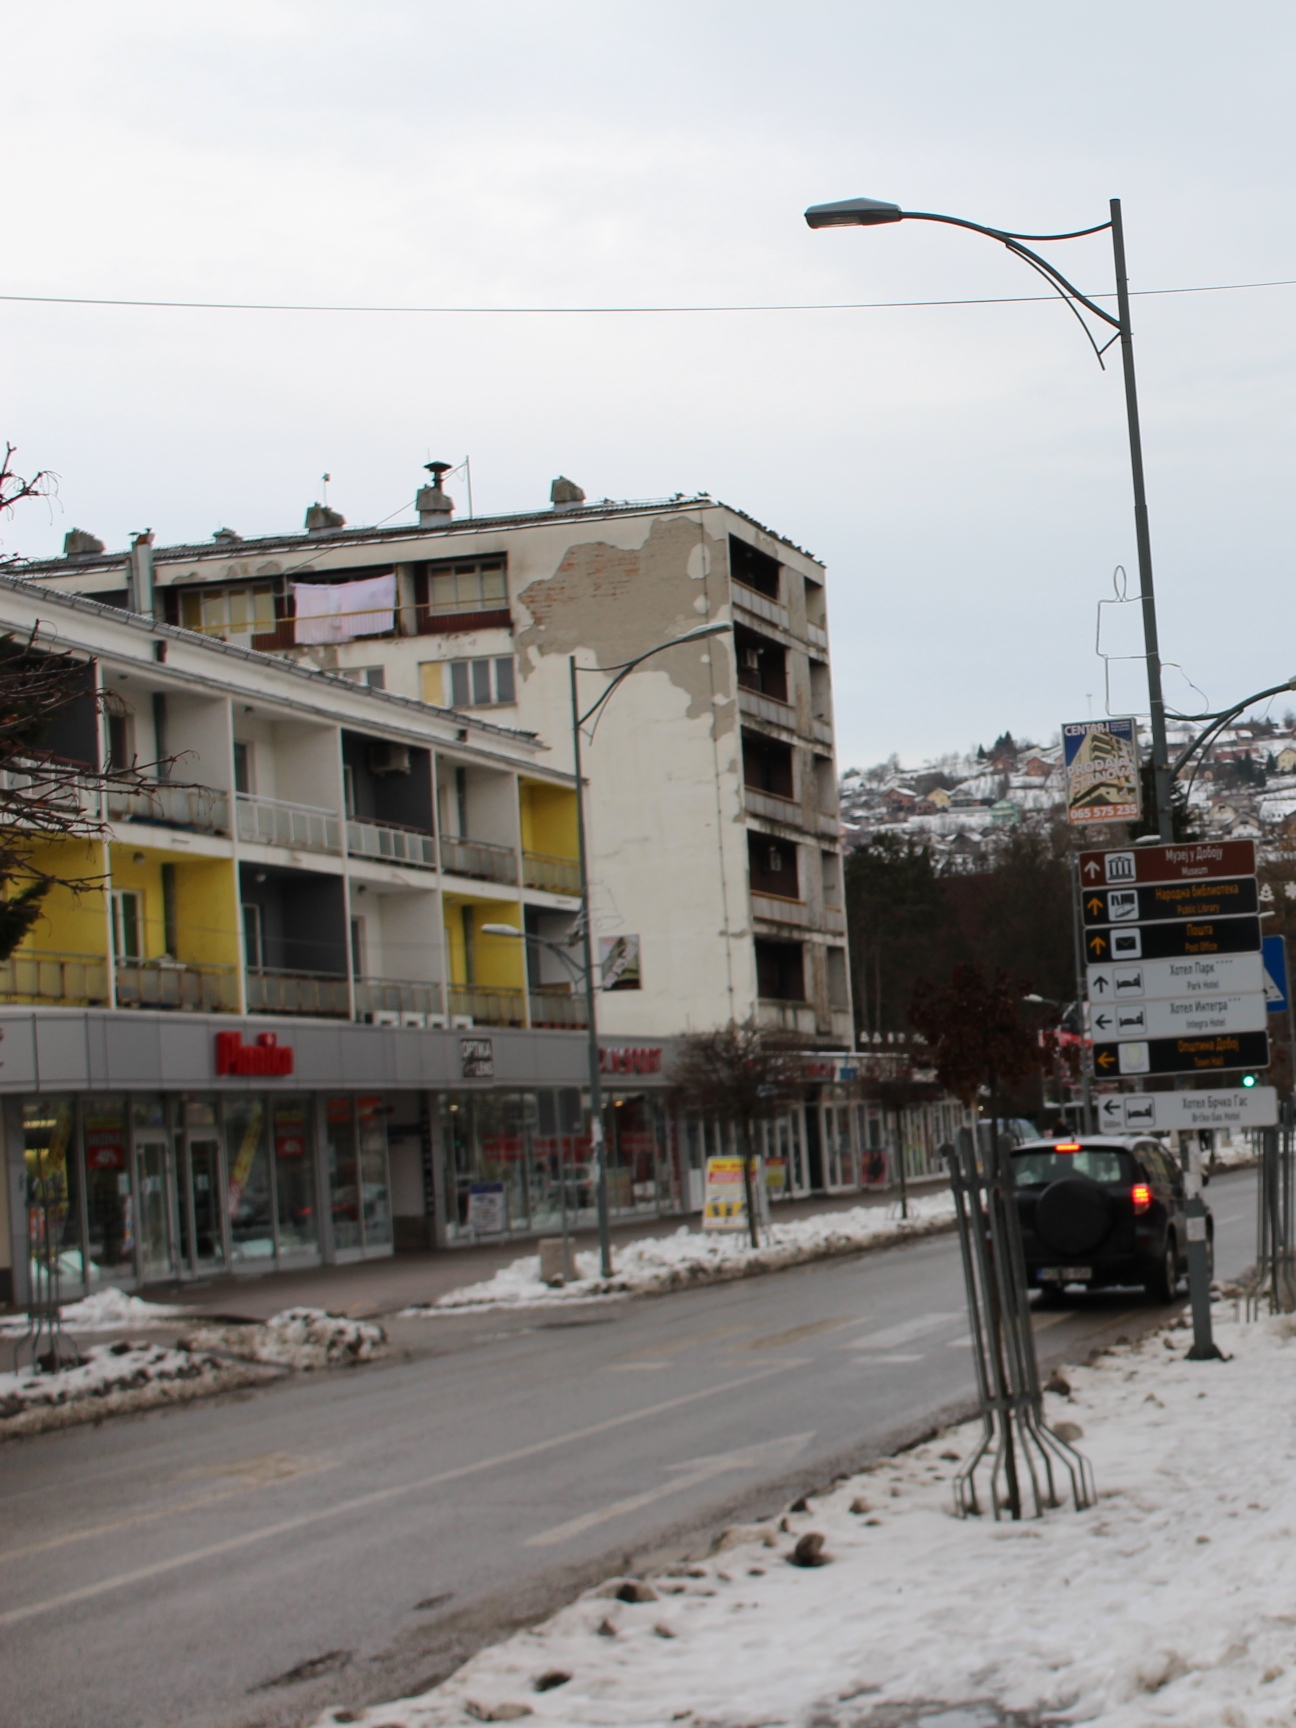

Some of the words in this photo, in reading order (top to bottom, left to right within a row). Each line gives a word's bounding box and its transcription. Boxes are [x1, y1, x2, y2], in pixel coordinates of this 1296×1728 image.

[1072, 766, 1136, 793] STANOVA
[1070, 808, 1091, 819] 065
[1093, 806, 1114, 817] 575
[1117, 803, 1137, 815] 235
[1181, 866, 1208, 876] Museum
[1155, 888, 1191, 902] Народна
[1192, 883, 1239, 897] библиотека
[1186, 923, 1213, 936] Пошта
[1169, 963, 1193, 976] Хотел
[1195, 961, 1215, 975] Парк
[1170, 1002, 1193, 1015] Хотел
